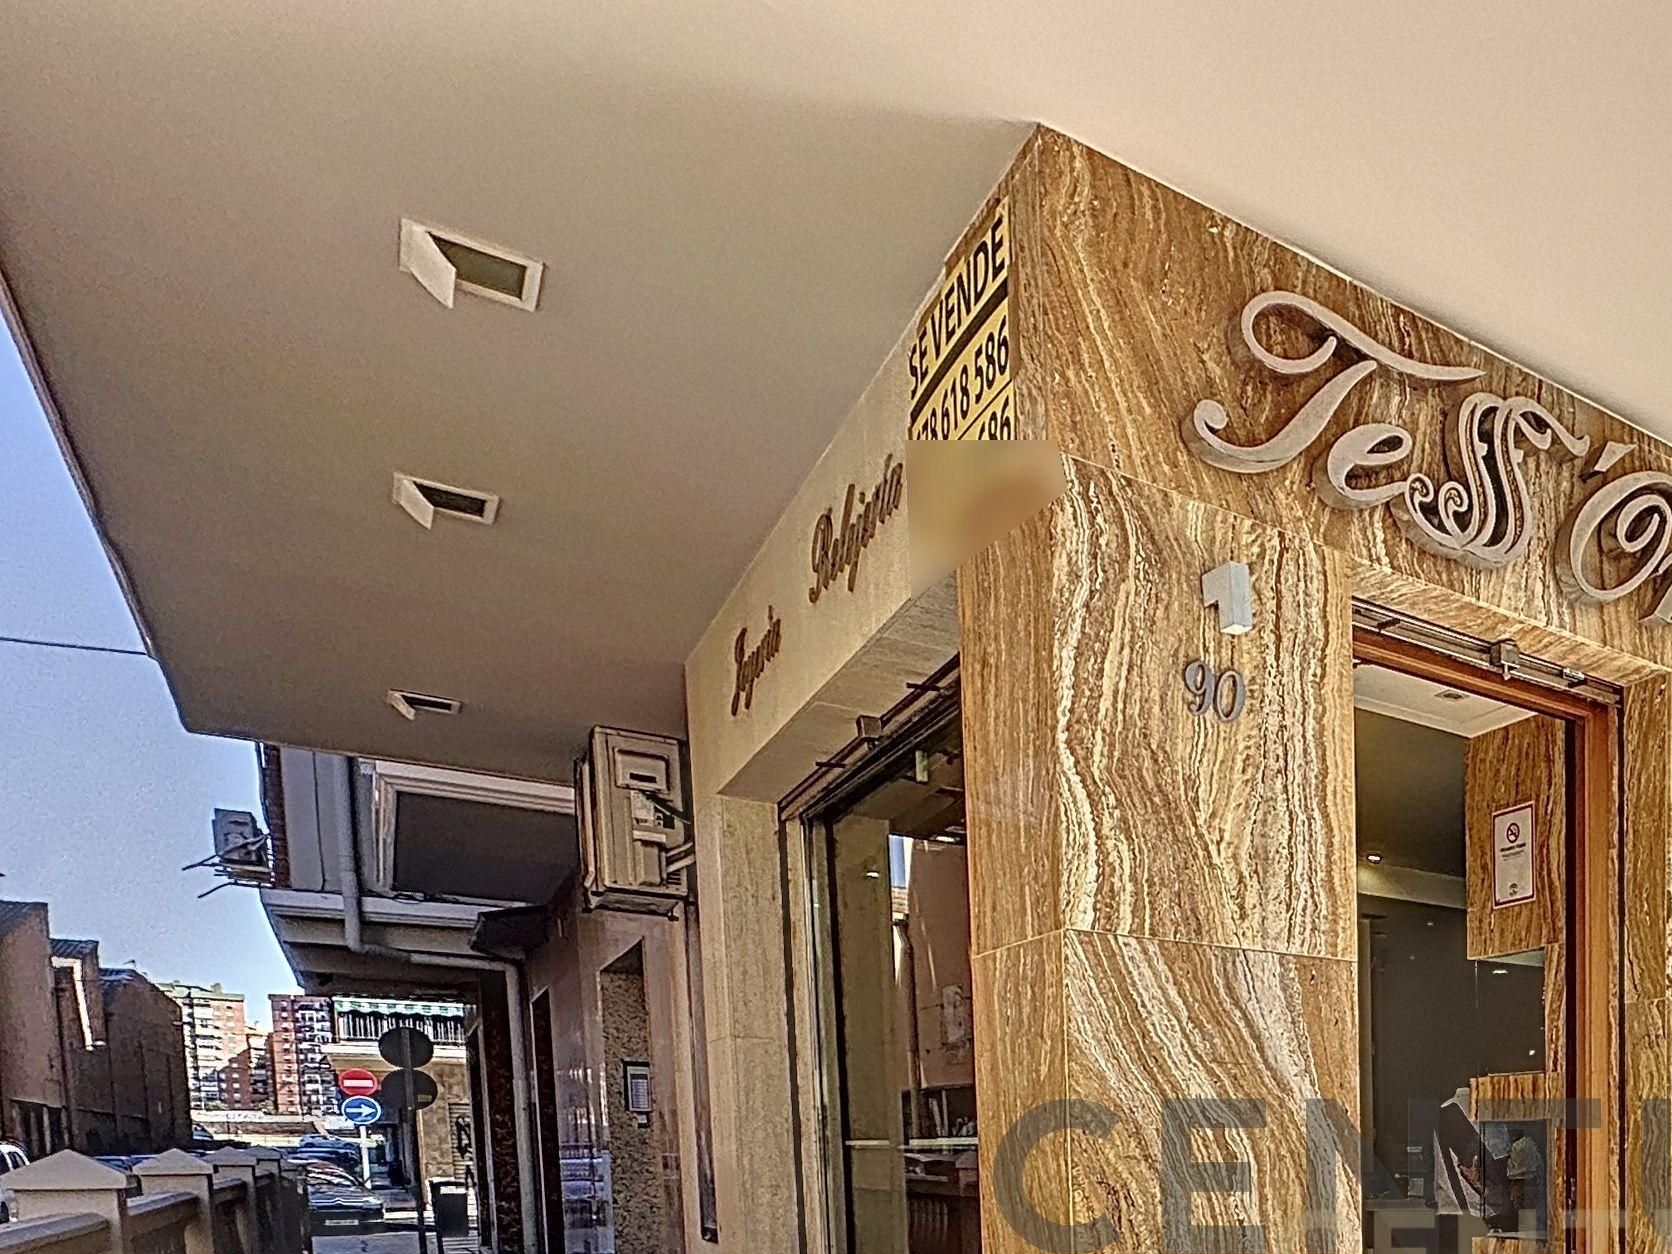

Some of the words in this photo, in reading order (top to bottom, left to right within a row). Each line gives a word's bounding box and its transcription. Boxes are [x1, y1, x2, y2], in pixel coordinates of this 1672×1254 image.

[909, 326, 929, 400] SE
[930, 216, 1005, 361] VENDE
[974, 315, 1009, 405] 586
[1184, 661, 1245, 722] 90
